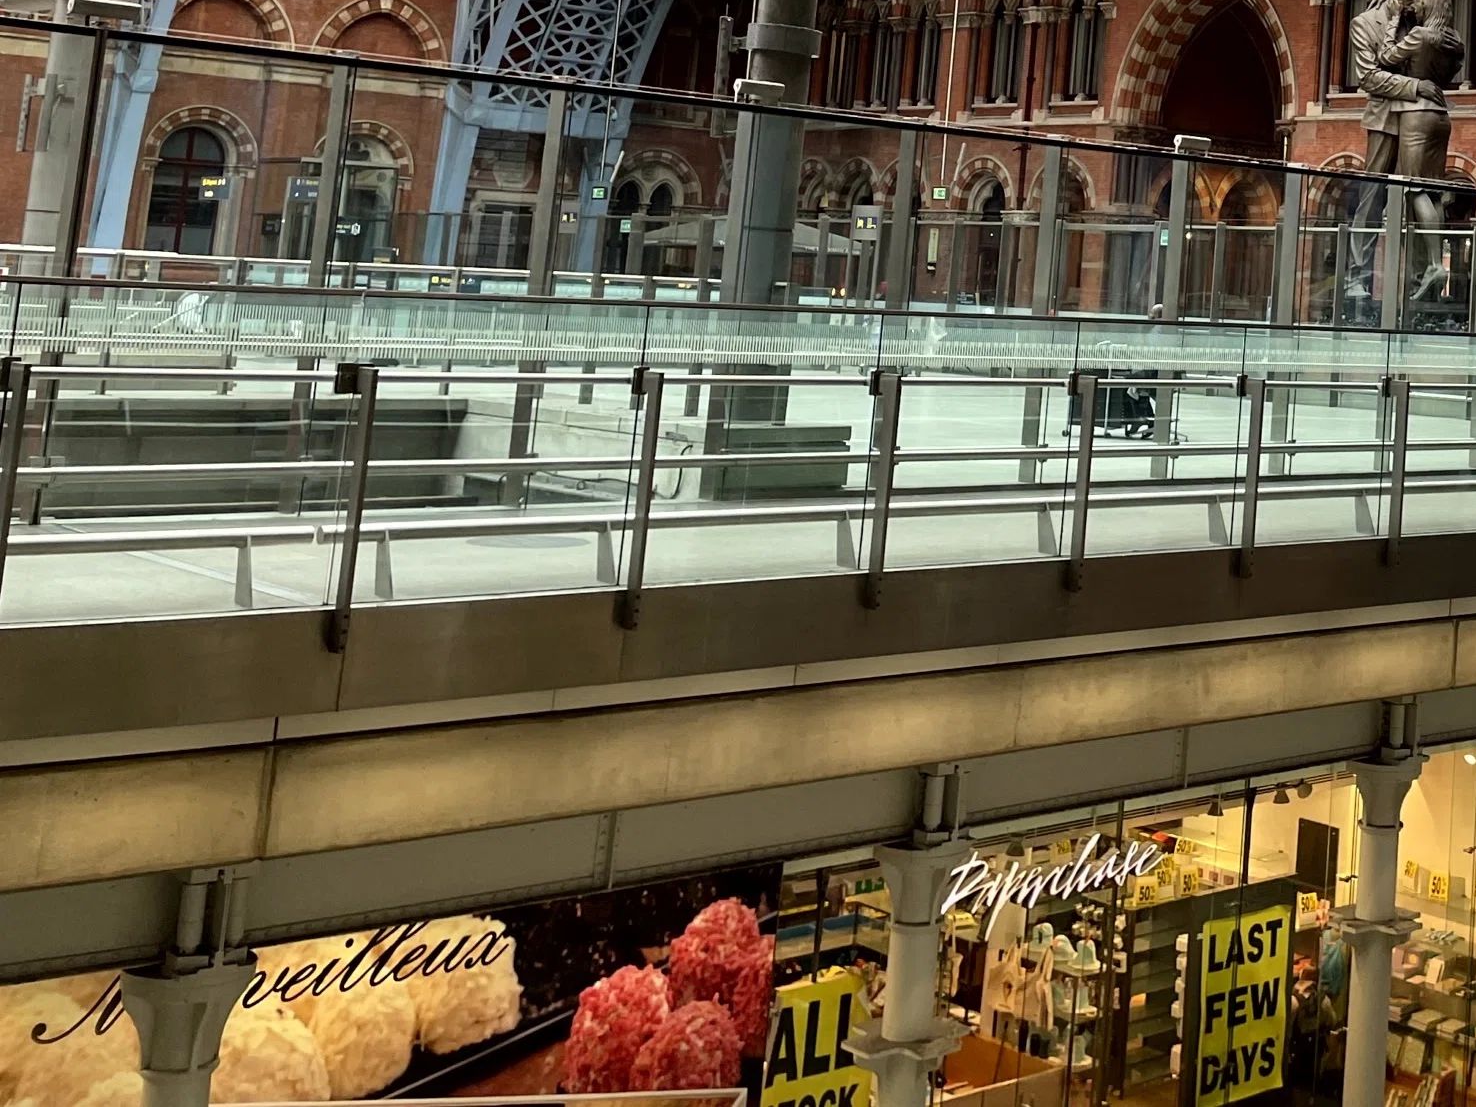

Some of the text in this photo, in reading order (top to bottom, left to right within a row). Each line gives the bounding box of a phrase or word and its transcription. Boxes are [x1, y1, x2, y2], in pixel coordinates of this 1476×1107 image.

[940, 833, 1165, 942] Paperchase
[1208, 918, 1283, 973] LAST
[1205, 977, 1281, 1034] FEW
[765, 993, 855, 1089] ALL
[1199, 1037, 1276, 1096] DAYS
